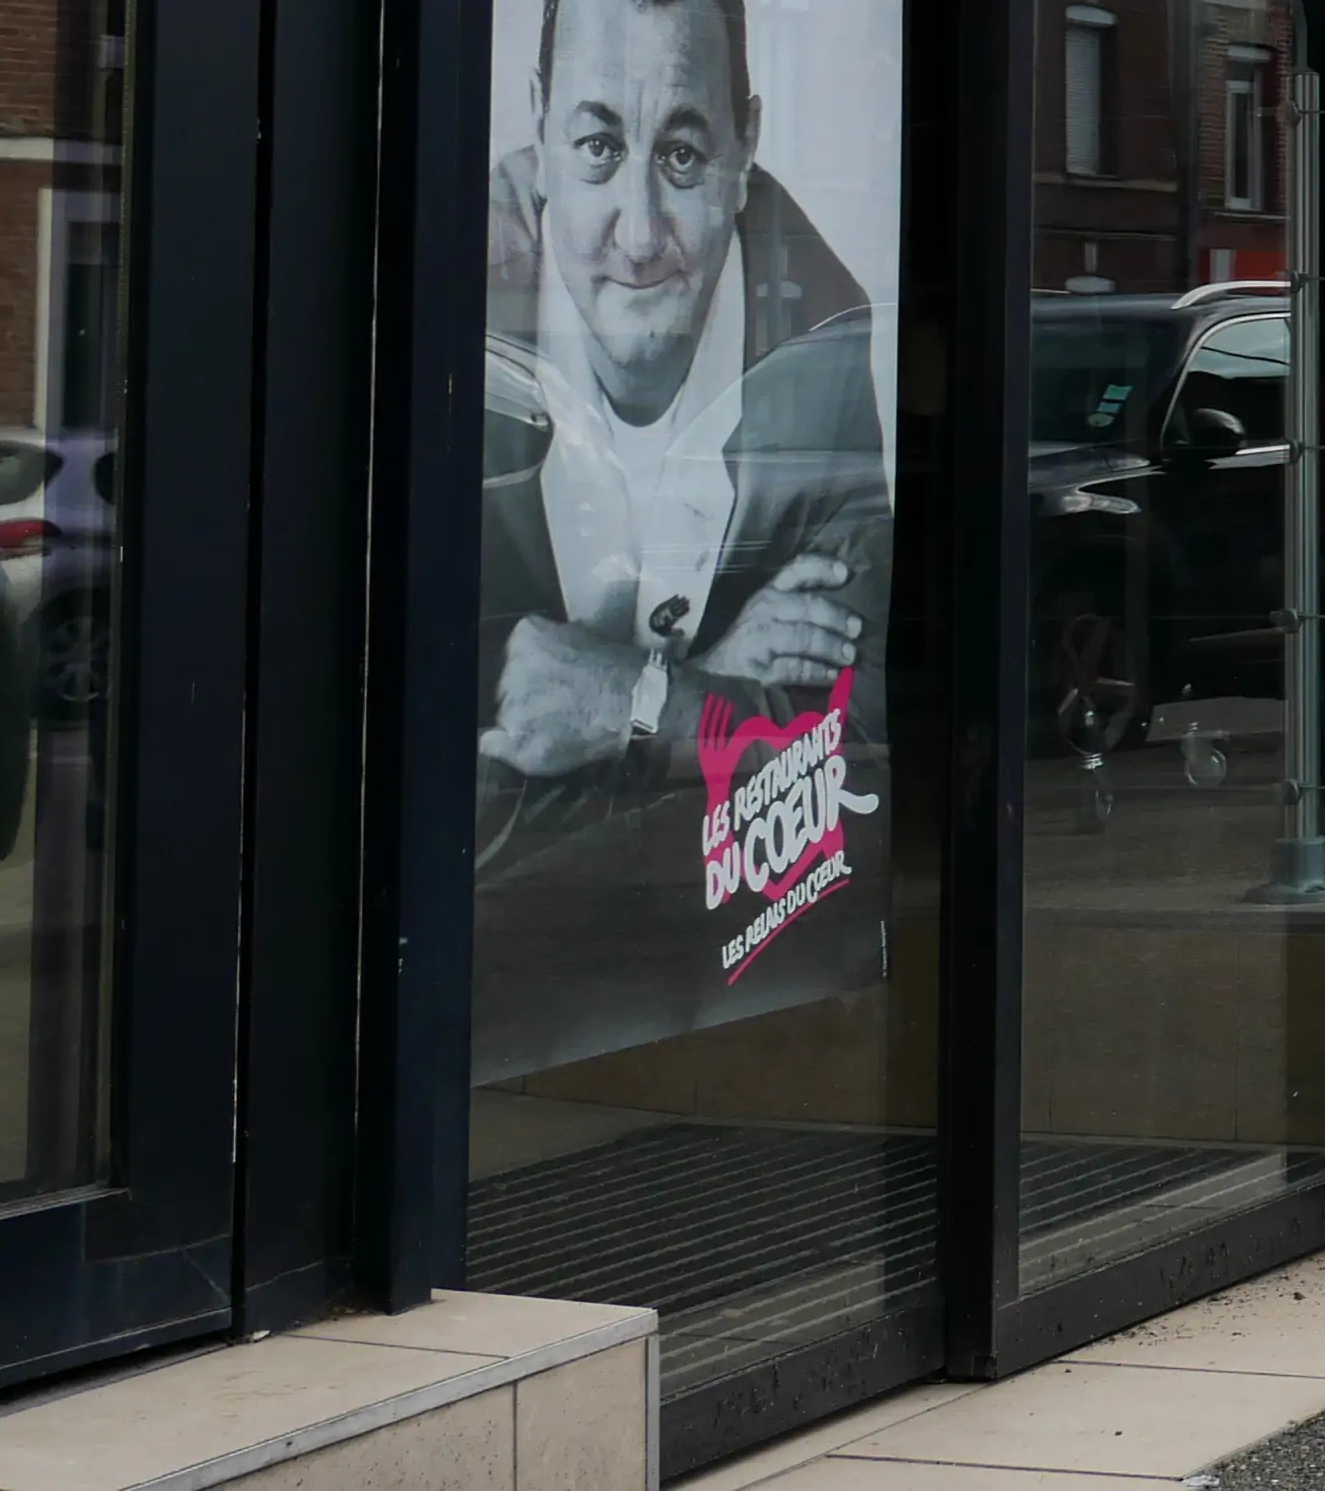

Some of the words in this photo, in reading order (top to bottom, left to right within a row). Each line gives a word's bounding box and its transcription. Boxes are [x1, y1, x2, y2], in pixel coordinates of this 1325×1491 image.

[703, 799, 731, 856] LES
[733, 707, 842, 831] RESTAURANTS
[705, 841, 741, 910] DU
[721, 934, 744, 969] LES
[786, 882, 805, 914] DU
